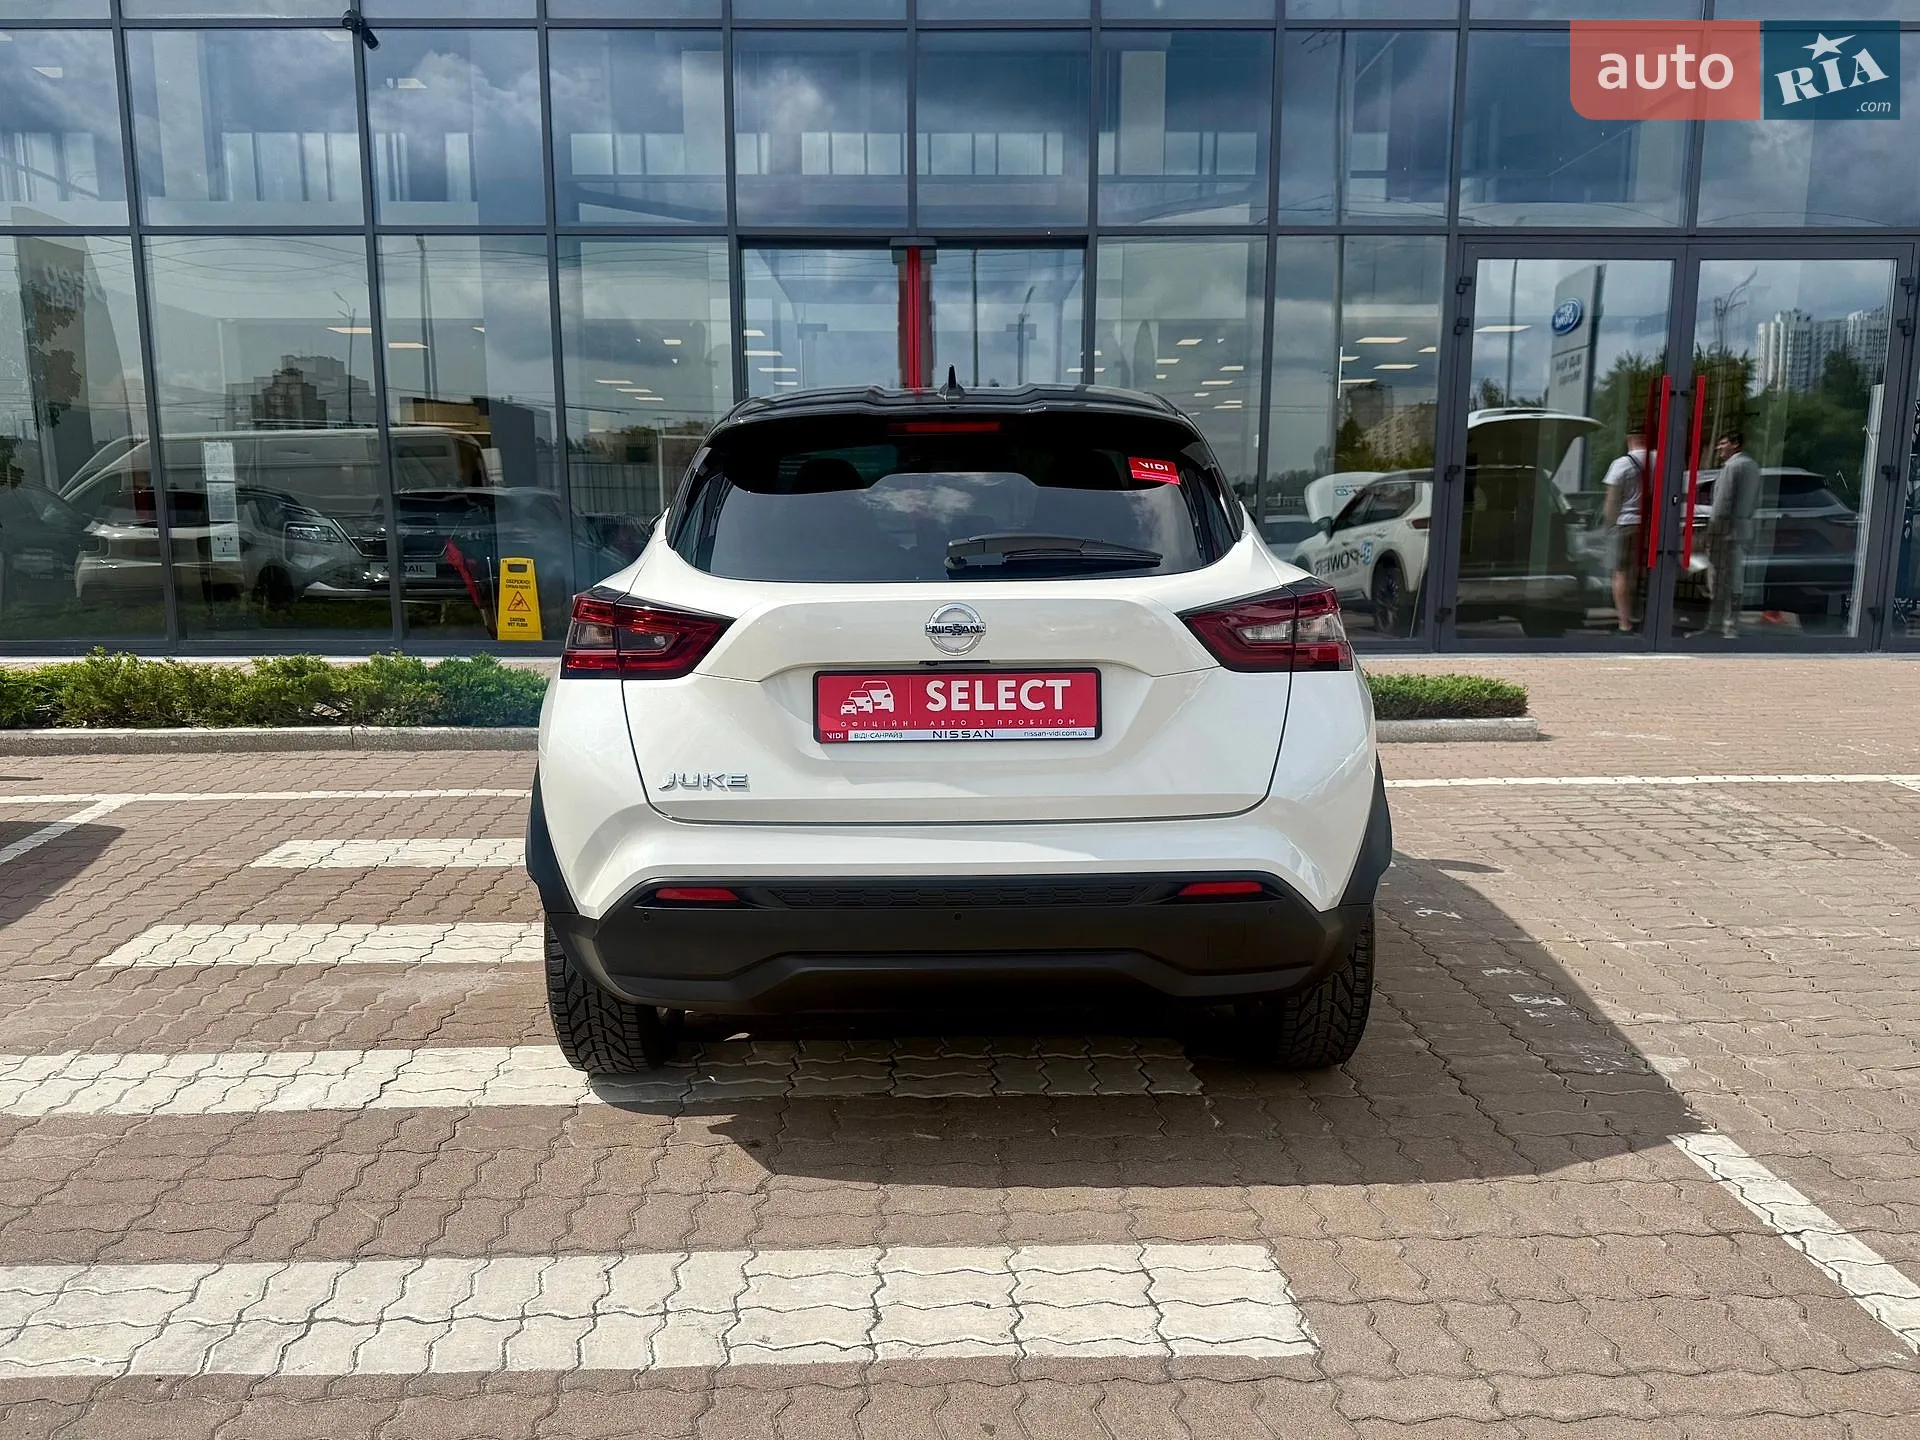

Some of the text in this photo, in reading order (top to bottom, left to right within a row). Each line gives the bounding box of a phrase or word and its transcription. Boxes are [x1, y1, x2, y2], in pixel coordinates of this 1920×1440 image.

[1138, 461, 1168, 471] VIDI
[931, 624, 980, 635] NISSAN
[926, 679, 1071, 712] SELECT
[932, 730, 994, 739] NISSAN
[1023, 729, 1087, 737] nissan-vidi.com.ua
[658, 772, 750, 792] JUKE
